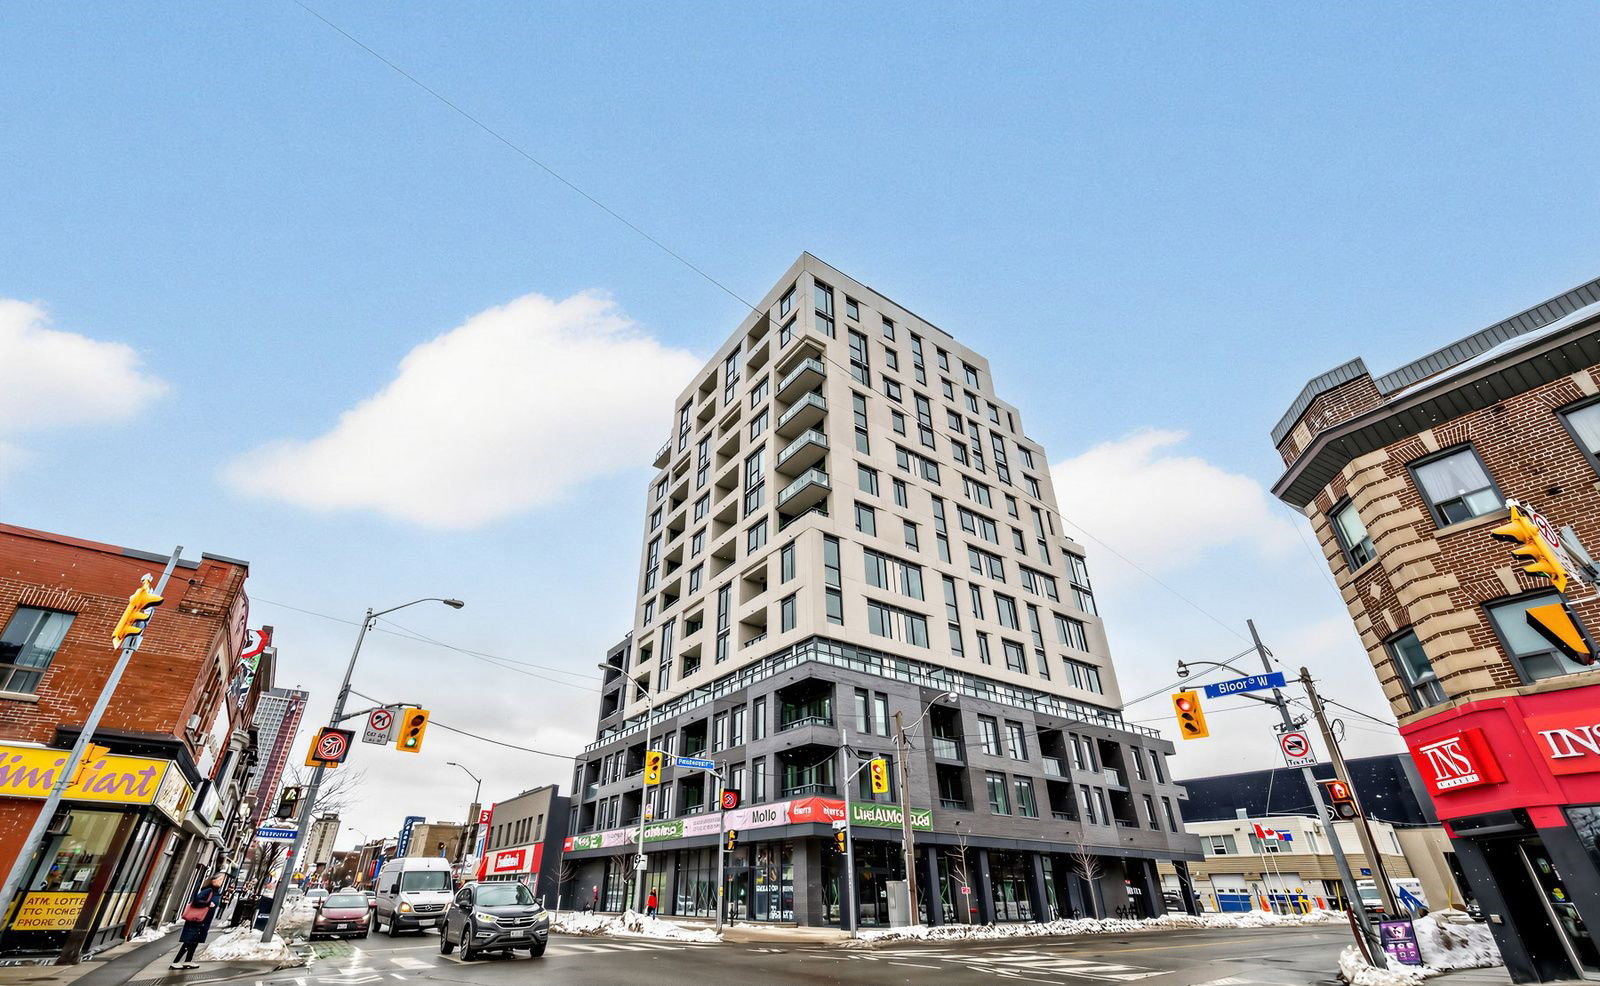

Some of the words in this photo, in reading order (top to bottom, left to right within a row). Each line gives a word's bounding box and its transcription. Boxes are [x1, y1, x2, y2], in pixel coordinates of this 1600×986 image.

[1218, 680, 1248, 694] Bloor
[1256, 675, 1269, 687] W
[0, 752, 66, 790] ini
[23, 907, 43, 916] TTC
